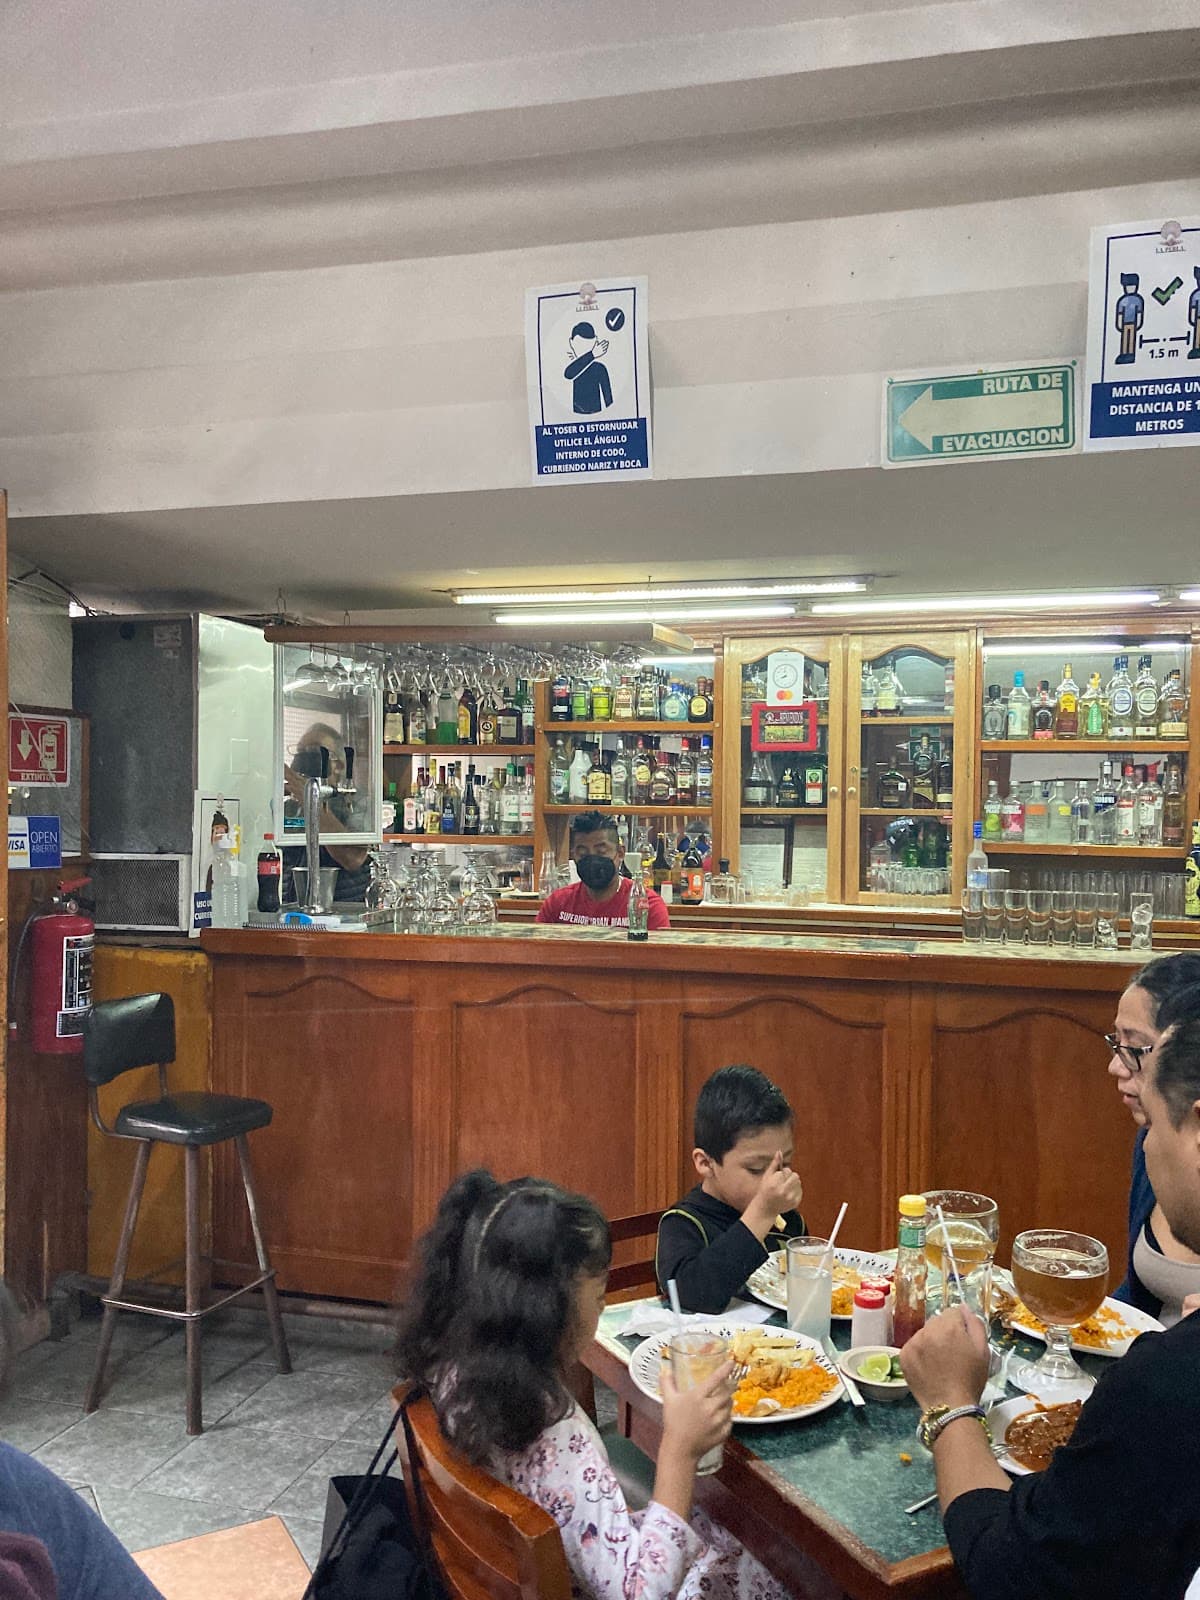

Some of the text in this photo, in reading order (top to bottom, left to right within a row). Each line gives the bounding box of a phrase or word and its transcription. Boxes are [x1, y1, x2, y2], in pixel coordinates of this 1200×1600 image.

[1149, 348, 1179, 358] 1.5 m
[983, 372, 1063, 394] RUTA DE
[1112, 383, 1181, 398] MANTENGA
[1109, 401, 1174, 415] DISTANCIA
[1176, 400, 1192, 411] DE
[543, 421, 638, 436] AL TOSER O ESTORNUDAR
[1135, 418, 1184, 432] METROS
[554, 435, 627, 447] UTILICE EL ÁNGULO
[942, 428, 1064, 452] EVACUACION
[555, 448, 627, 460] INTERNO DE CODO,
[543, 459, 641, 473] CUBRIENDO NARIZ Y BOCA
[30, 831, 58, 844] OPEN
[31, 844, 57, 853] ABIERTO
[559, 911, 589, 925] SUPERIOR
